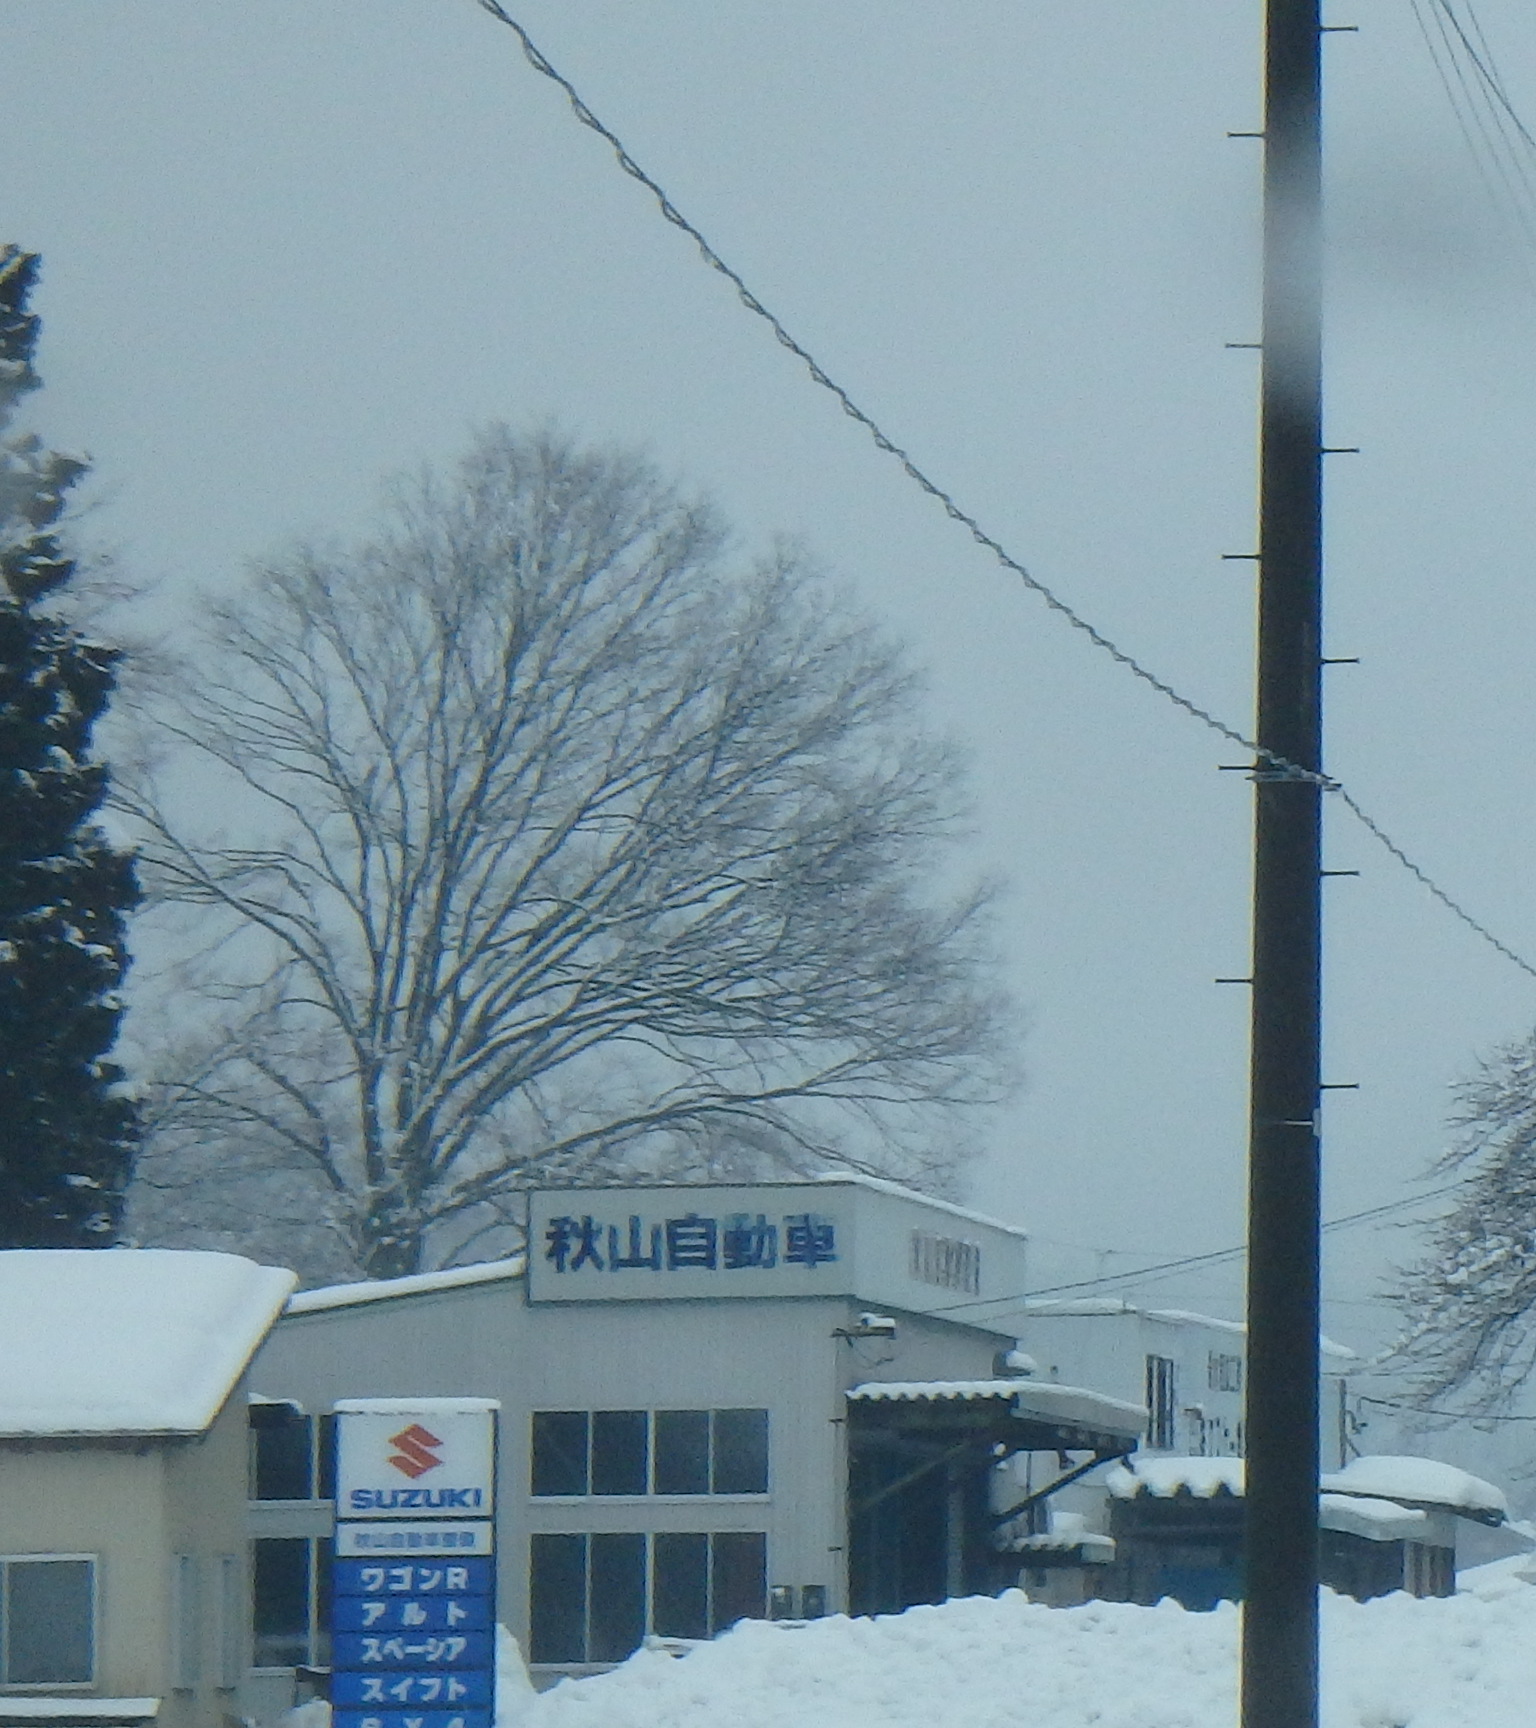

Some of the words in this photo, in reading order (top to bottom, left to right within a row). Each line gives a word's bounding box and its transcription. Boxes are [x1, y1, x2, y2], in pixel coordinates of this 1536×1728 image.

[545, 1213, 840, 1273] 秋山自動車
[351, 1489, 481, 1508] SUZUKI
[361, 1567, 467, 1590] ワゴンR
[362, 1602, 466, 1626] アルト
[362, 1678, 466, 1701] スイフト
